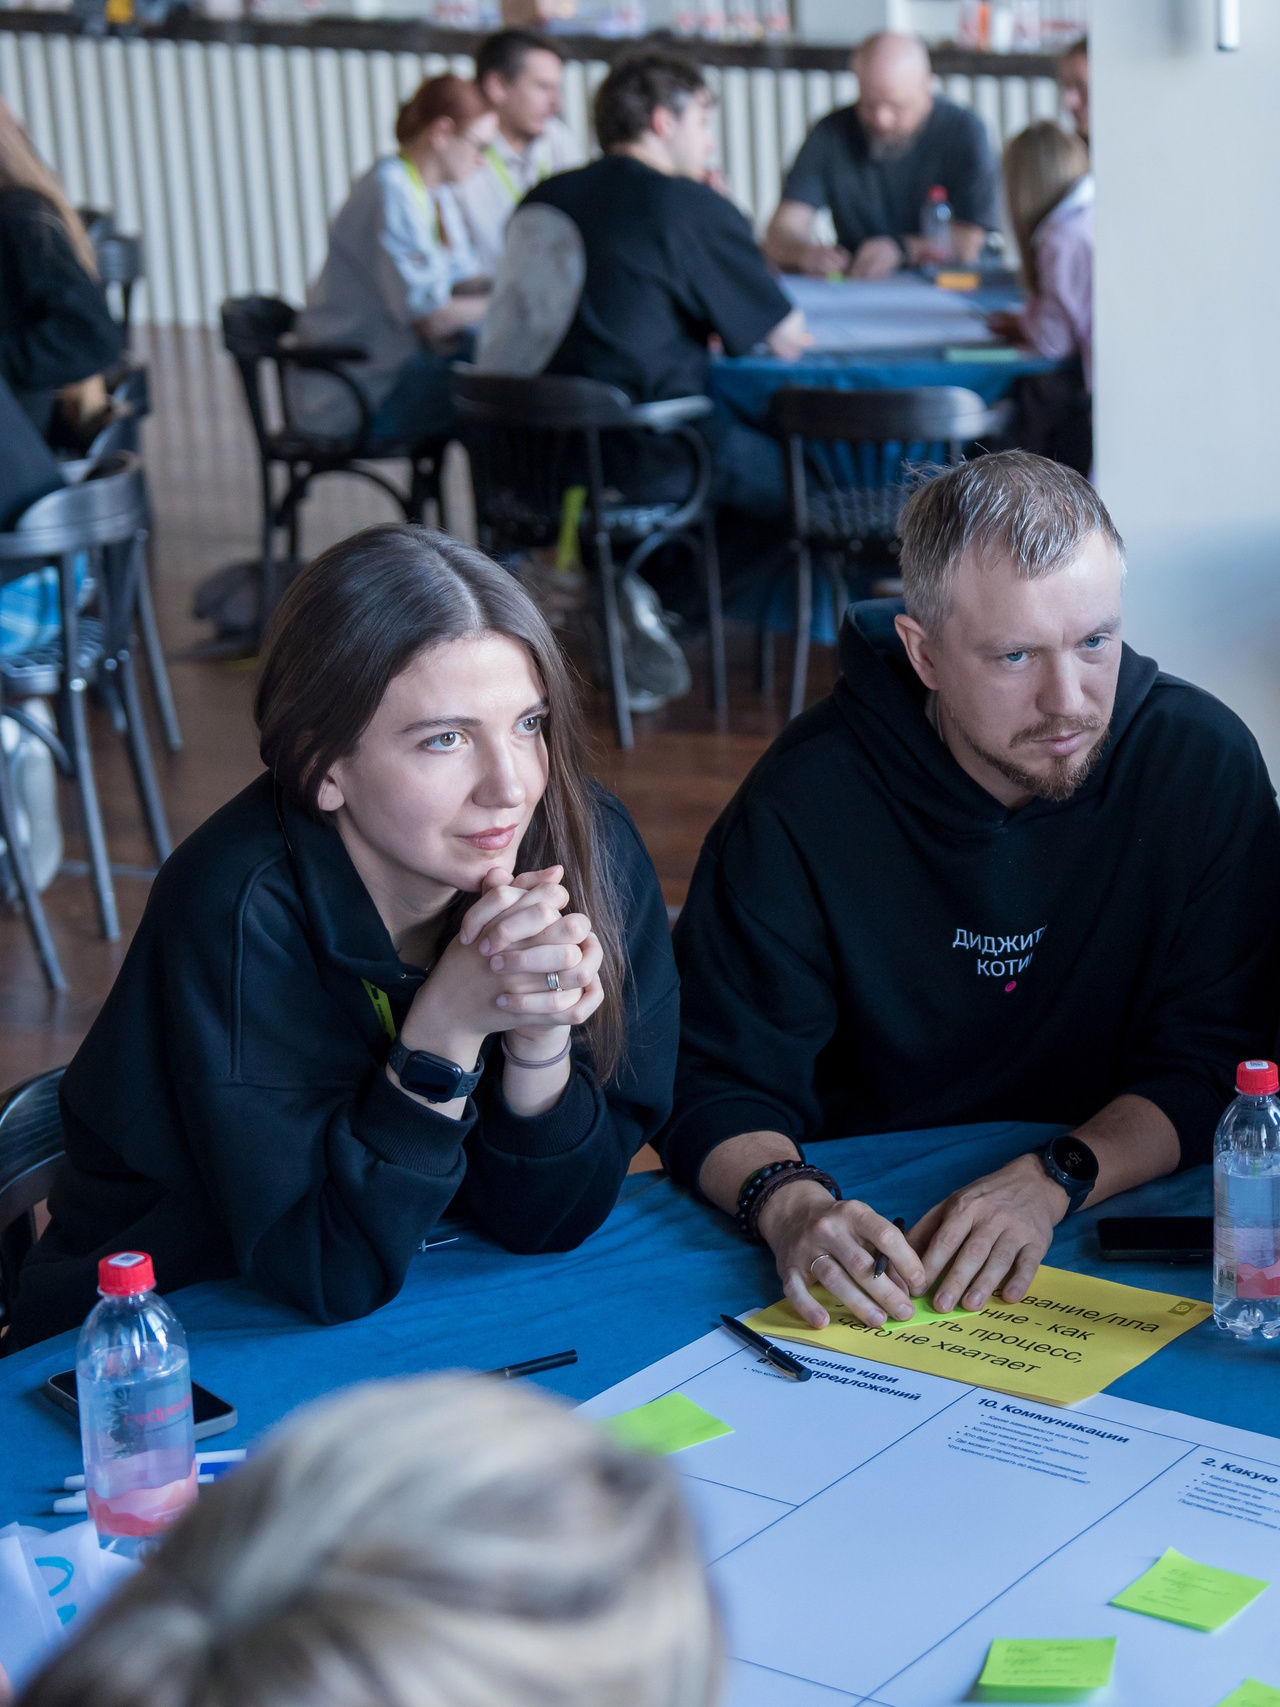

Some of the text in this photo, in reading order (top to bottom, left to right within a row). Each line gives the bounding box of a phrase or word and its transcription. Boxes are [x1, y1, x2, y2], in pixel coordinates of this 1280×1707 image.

[836, 1317, 1042, 1374] чего не хватает
[968, 1327, 1083, 1364] процесс,
[1046, 1322, 1097, 1342] как
[811, 1369, 922, 1401] предложений
[856, 1368, 900, 1384] идеи
[978, 1398, 1130, 1444] 10. Коммуникации
[1201, 1457, 1216, 1467] 2.
[1220, 1462, 1278, 1483] Какую
